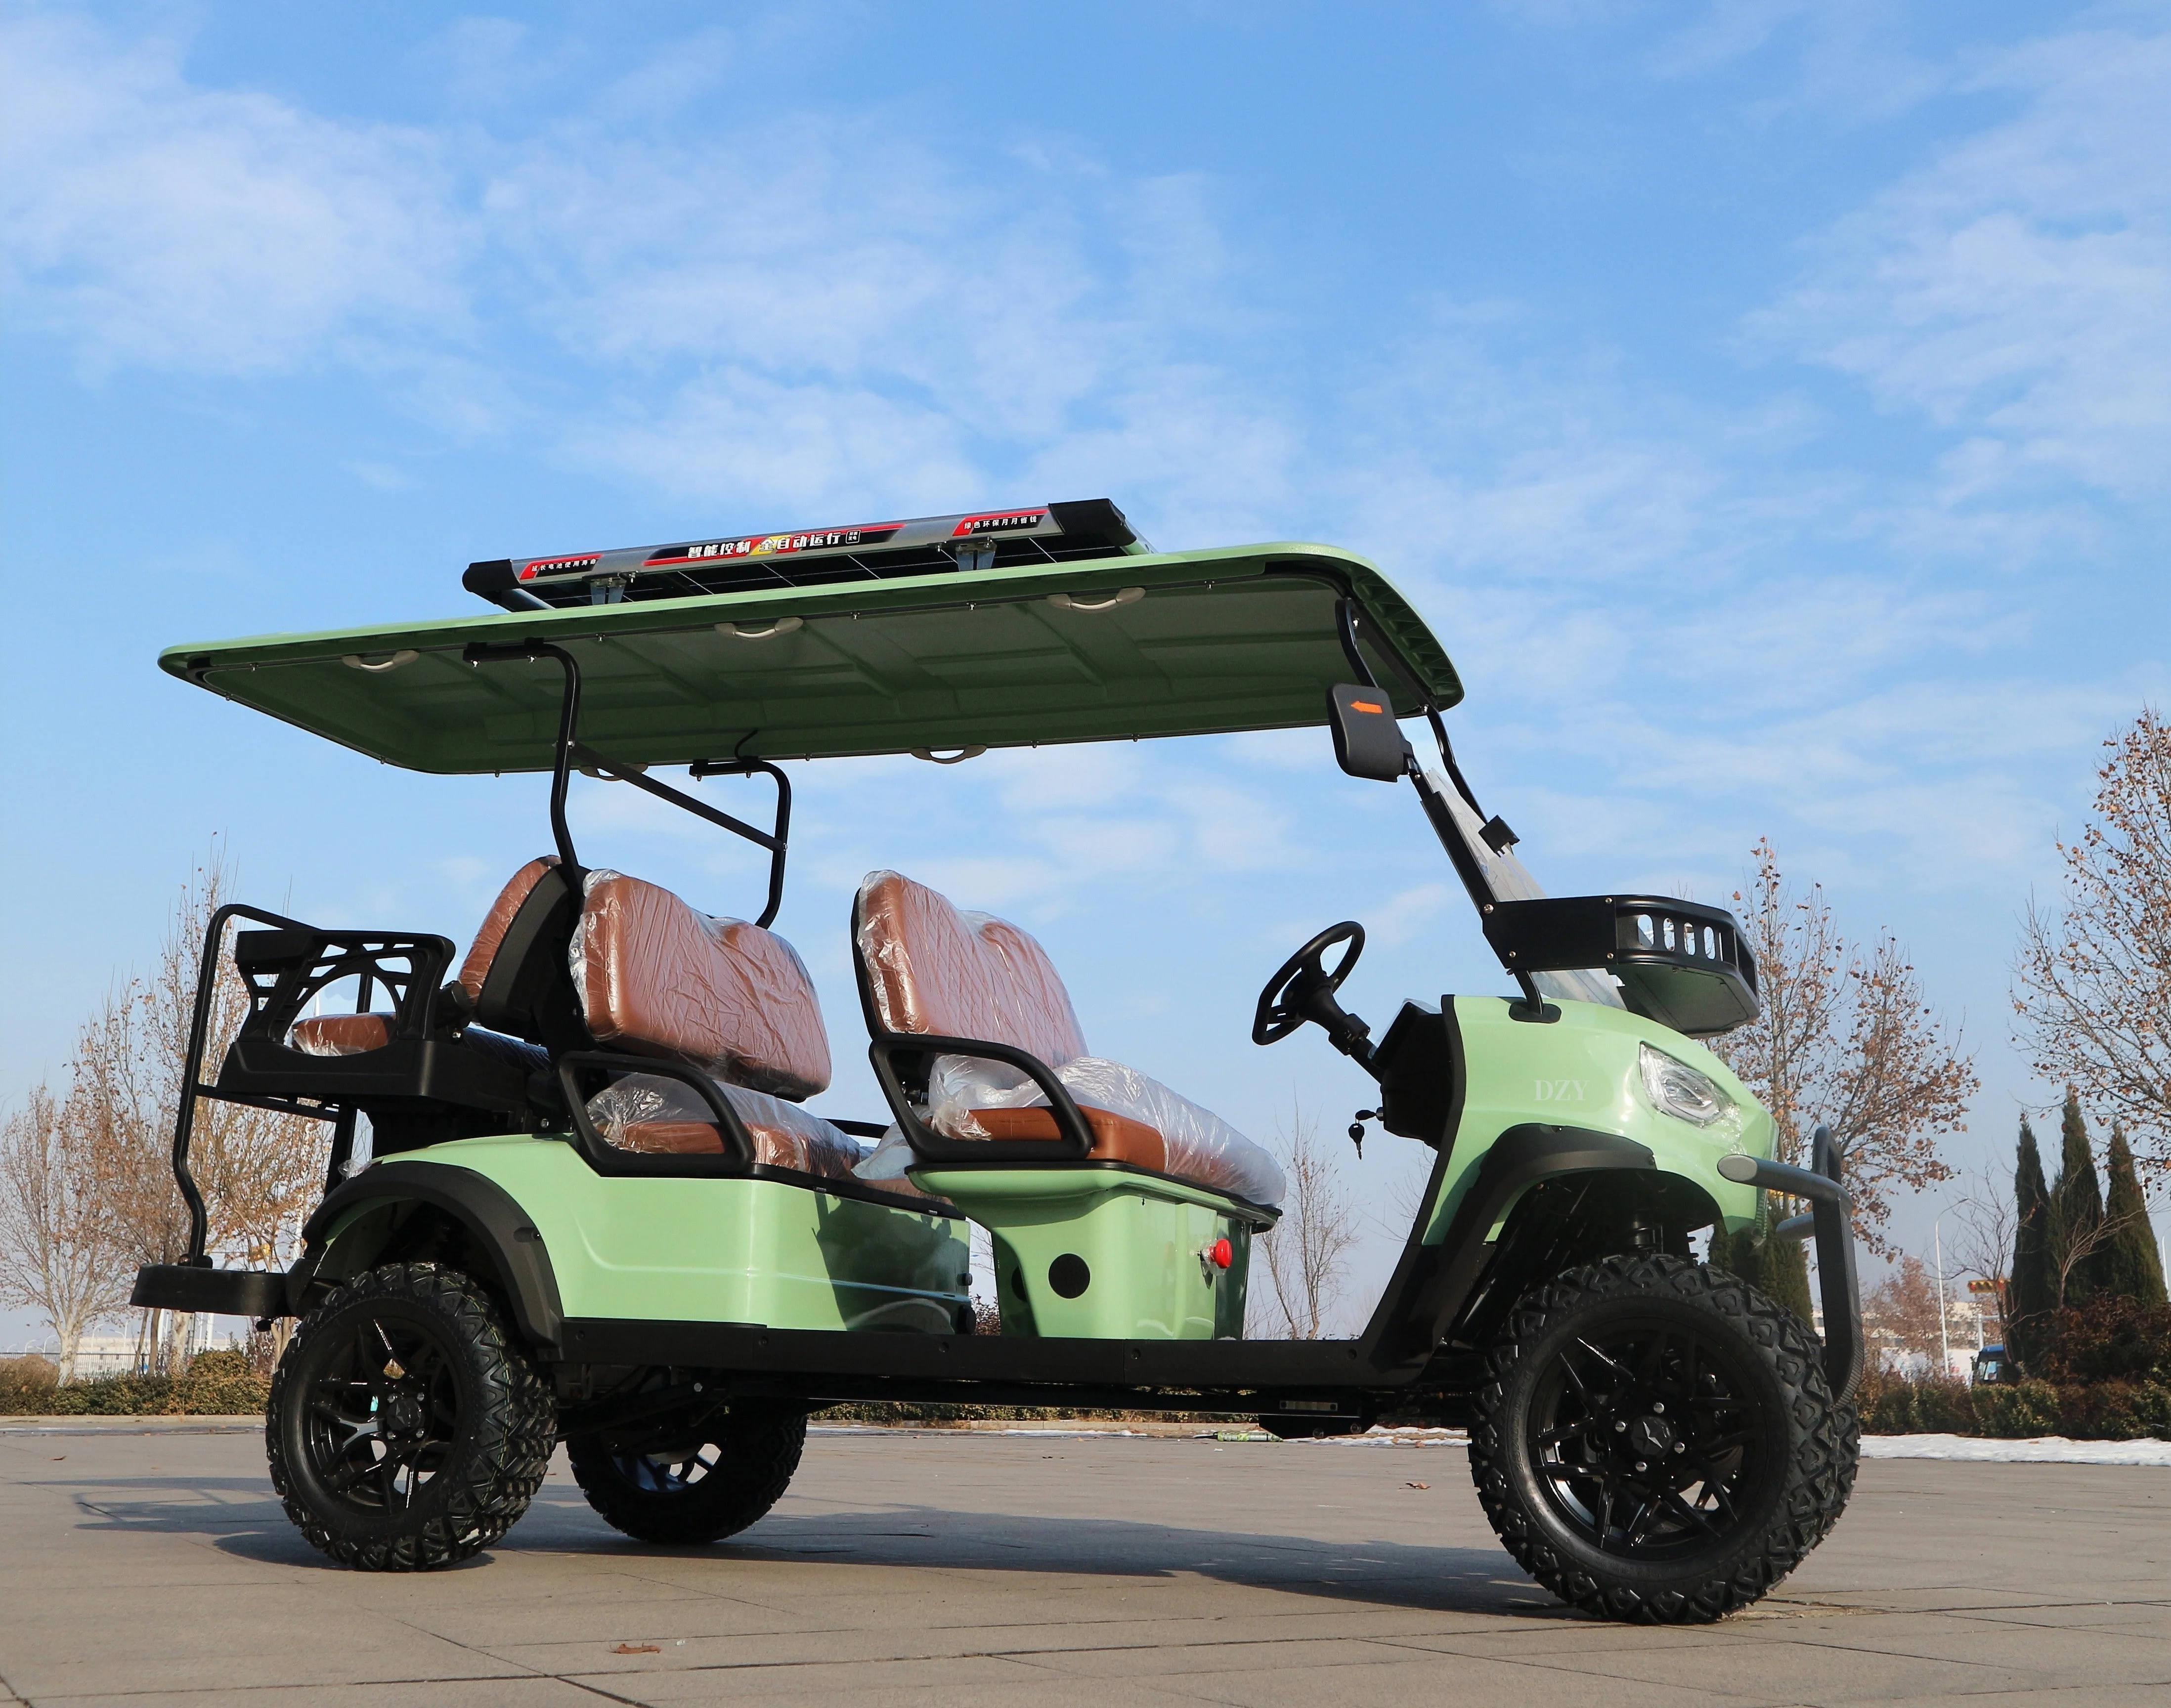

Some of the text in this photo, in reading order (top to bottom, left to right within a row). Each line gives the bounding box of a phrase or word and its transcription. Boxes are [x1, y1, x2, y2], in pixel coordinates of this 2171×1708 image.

[964, 515, 1037, 529] 绿色环保月月省钱
[688, 532, 841, 558] 智能控制 全自动运行
